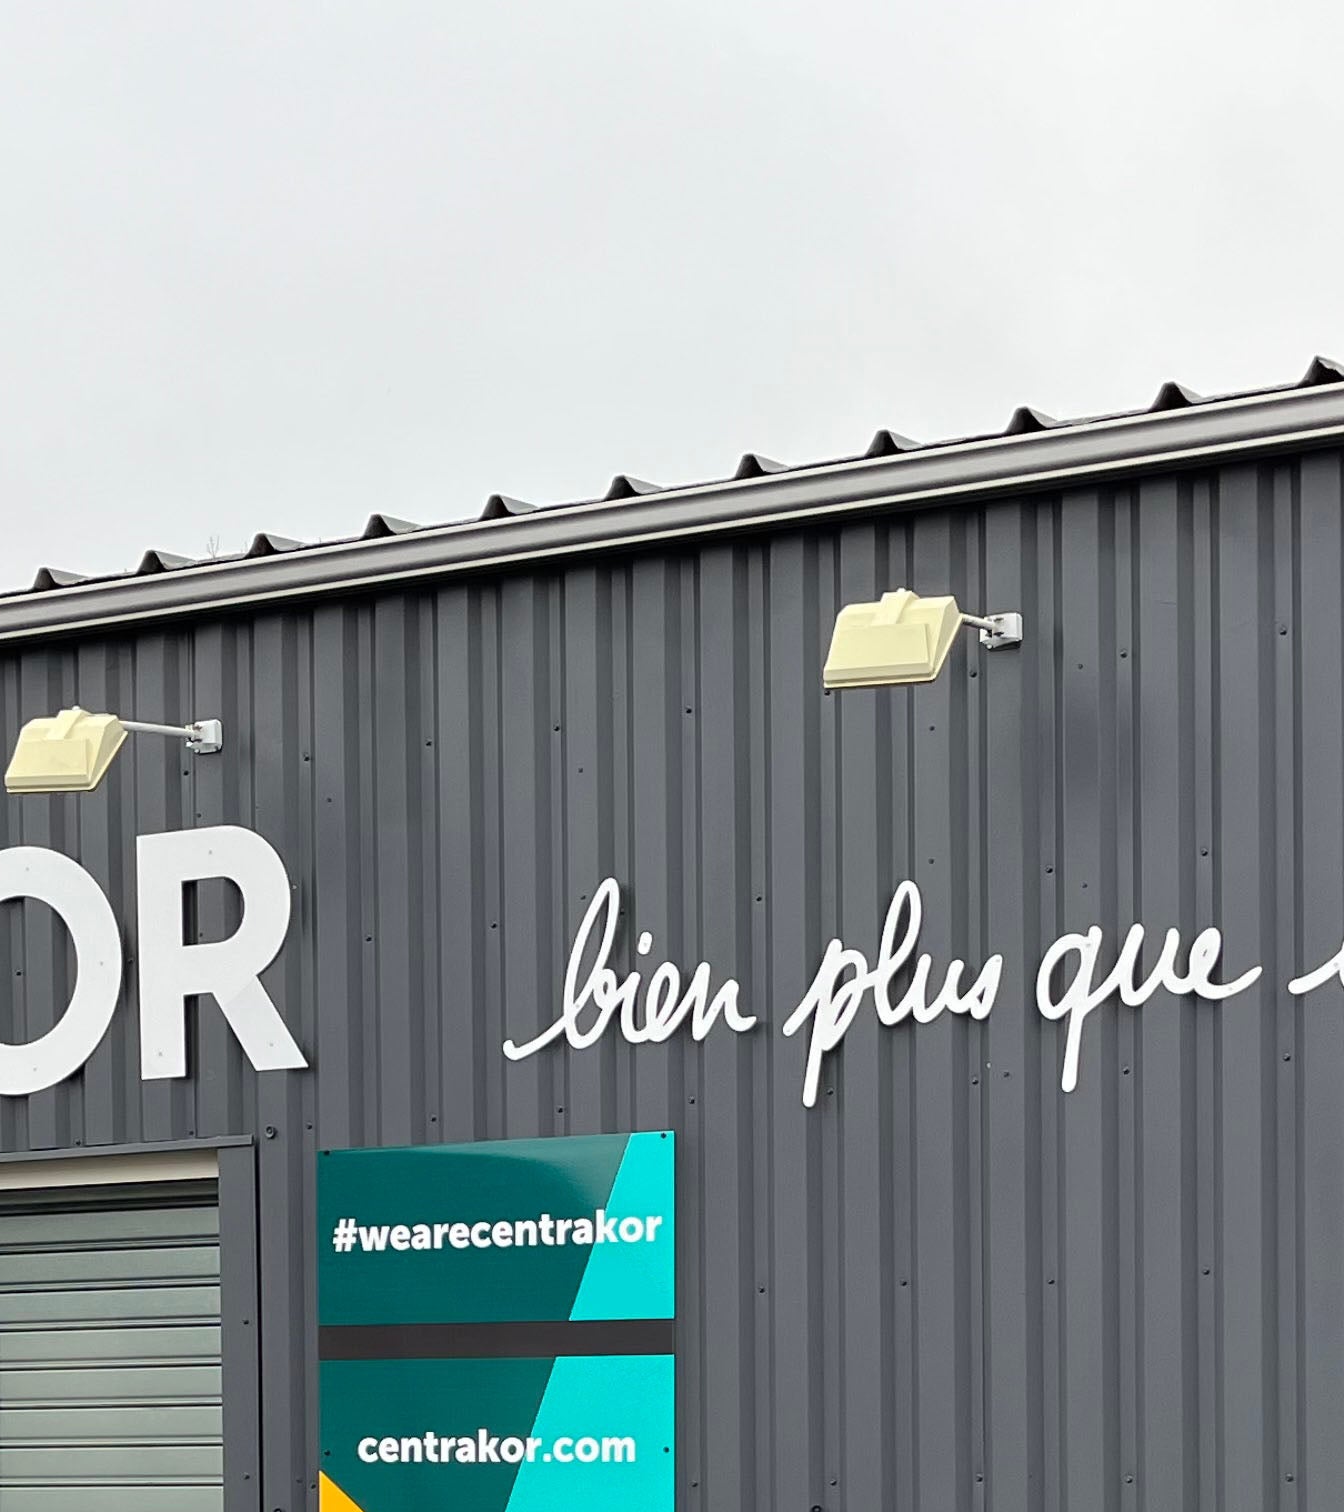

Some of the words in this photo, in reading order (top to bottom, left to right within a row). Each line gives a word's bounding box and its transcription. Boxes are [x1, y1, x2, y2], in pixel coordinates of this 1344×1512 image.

[503, 877, 757, 1061] bien
[782, 880, 1003, 1108] plus
[1037, 922, 1263, 1093] que
[332, 1209, 663, 1253] #wearecentrakor
[357, 1428, 636, 1464] centrakor.com
